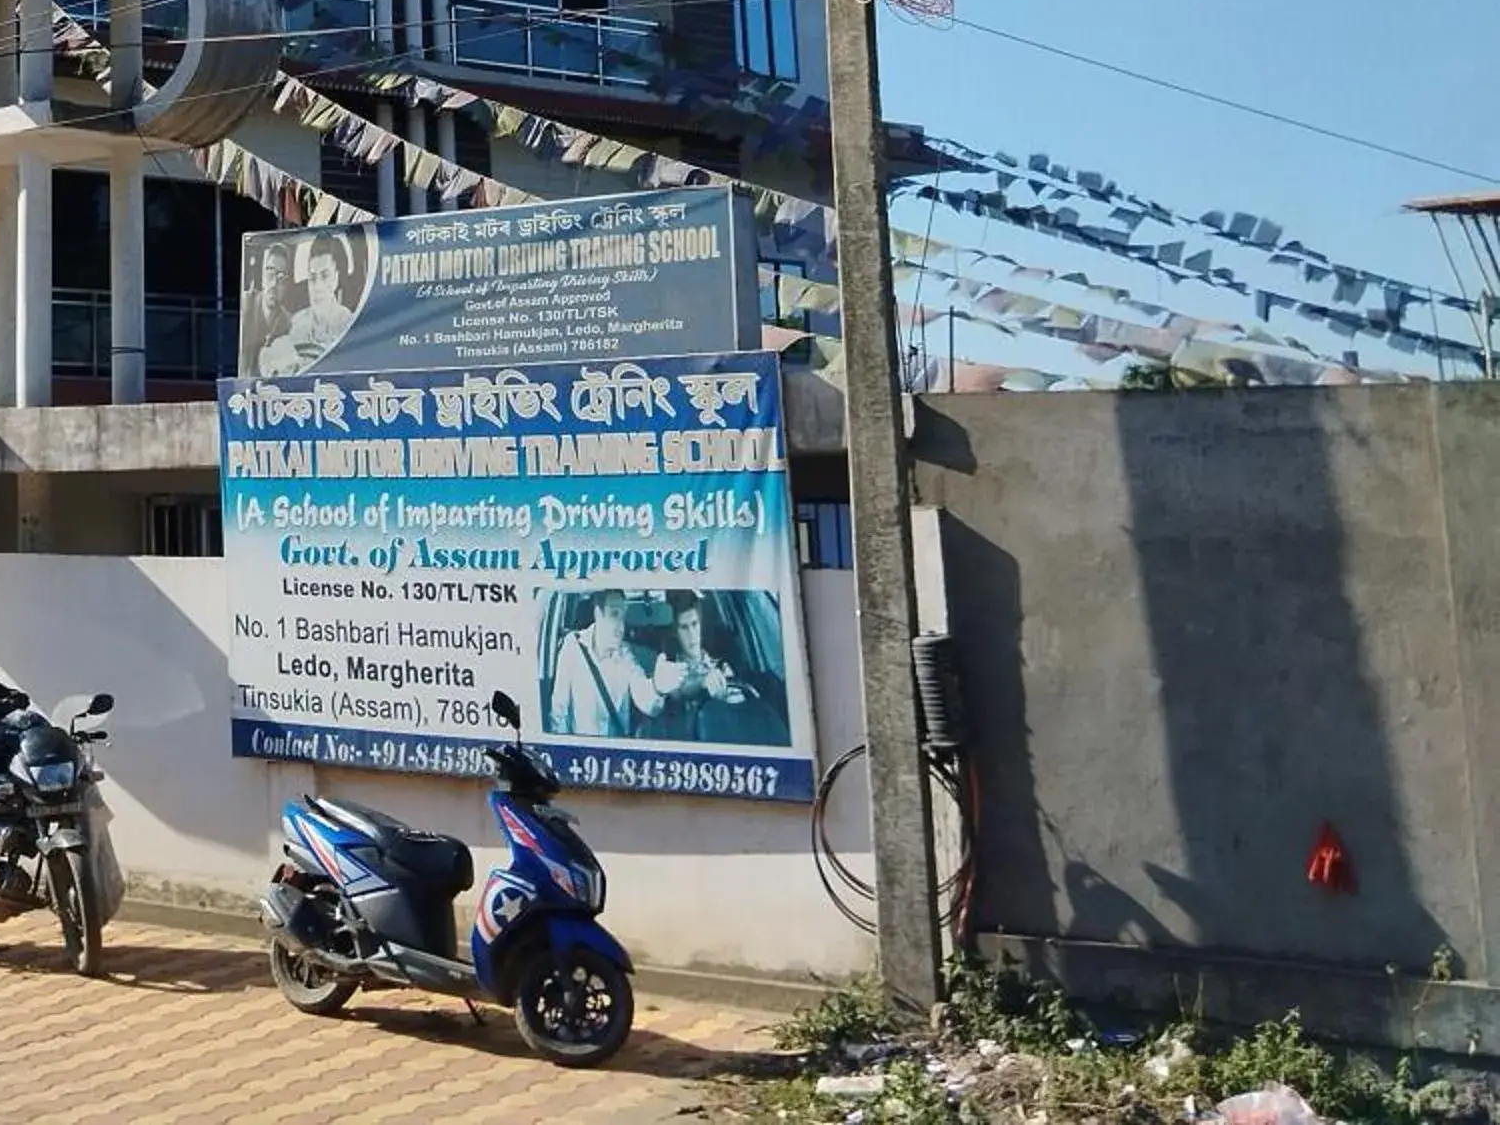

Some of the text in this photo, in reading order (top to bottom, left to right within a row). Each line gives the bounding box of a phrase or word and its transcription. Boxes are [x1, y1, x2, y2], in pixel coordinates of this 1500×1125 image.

[382, 251, 435, 285] PATKAI
[439, 246, 495, 279] MOTOR
[498, 239, 567, 276] DRIVING
[649, 225, 721, 264] SCHOOL
[434, 283, 473, 298] School
[475, 281, 488, 296] of
[490, 275, 558, 294] Imparting
[560, 273, 610, 289] Driving
[509, 295, 549, 309] Assam
[552, 290, 611, 308] Approved
[399, 333, 422, 346] No.
[608, 318, 684, 335] Margherita
[453, 307, 618, 328] License No. 130/TL/TSK
[513, 341, 568, 356] (Assam)
[228, 427, 786, 478] PATKAI MOTOR DRIVING TRAINING SCHOOL
[237, 488, 765, 538] (A School of Imparting Driving Skills)
[280, 534, 709, 579] Govt. of Assam Approved
[283, 578, 518, 604] License No. 130/TL/TSK
[235, 614, 521, 656] No. 1 Bashbari Hamukjan,
[277, 652, 475, 688] Ledo, Margherita
[238, 684, 323, 714] Tinsukia
[251, 727, 318, 760] Contact
[569, 754, 779, 796] +91-8453989567
